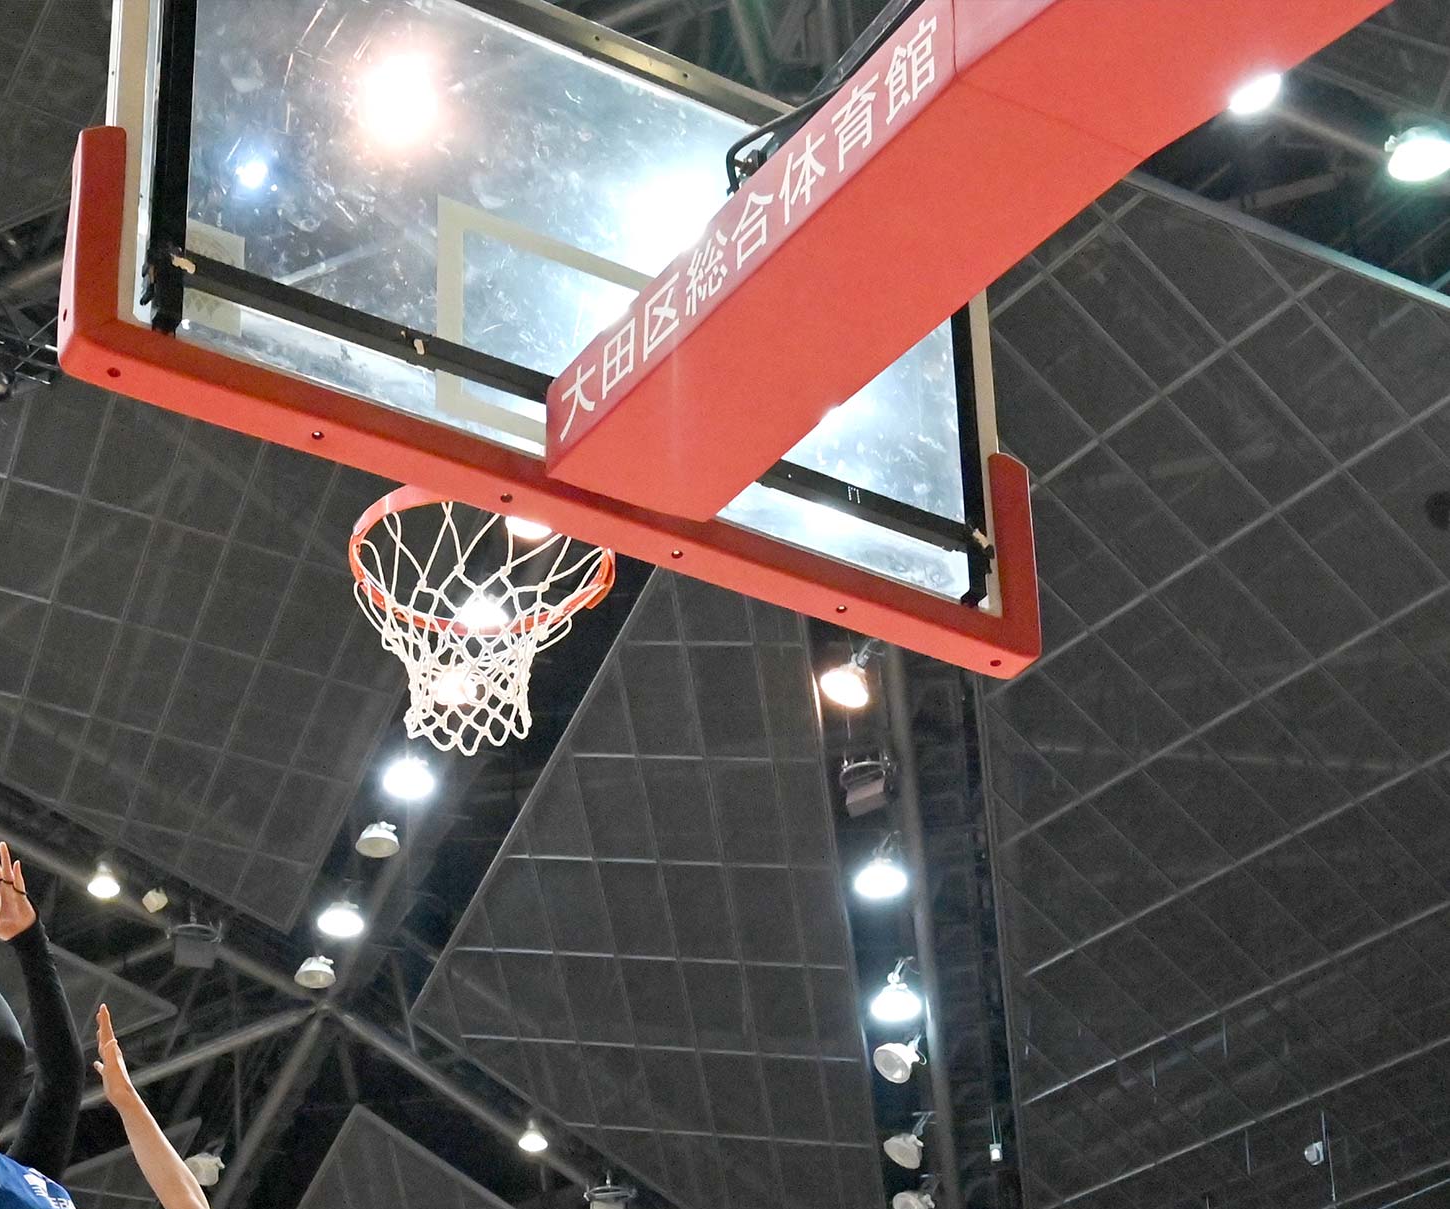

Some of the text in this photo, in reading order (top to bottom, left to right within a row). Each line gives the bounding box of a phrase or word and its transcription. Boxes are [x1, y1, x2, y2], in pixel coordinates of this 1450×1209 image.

[559, 16, 936, 441] 大田区総合体育館
